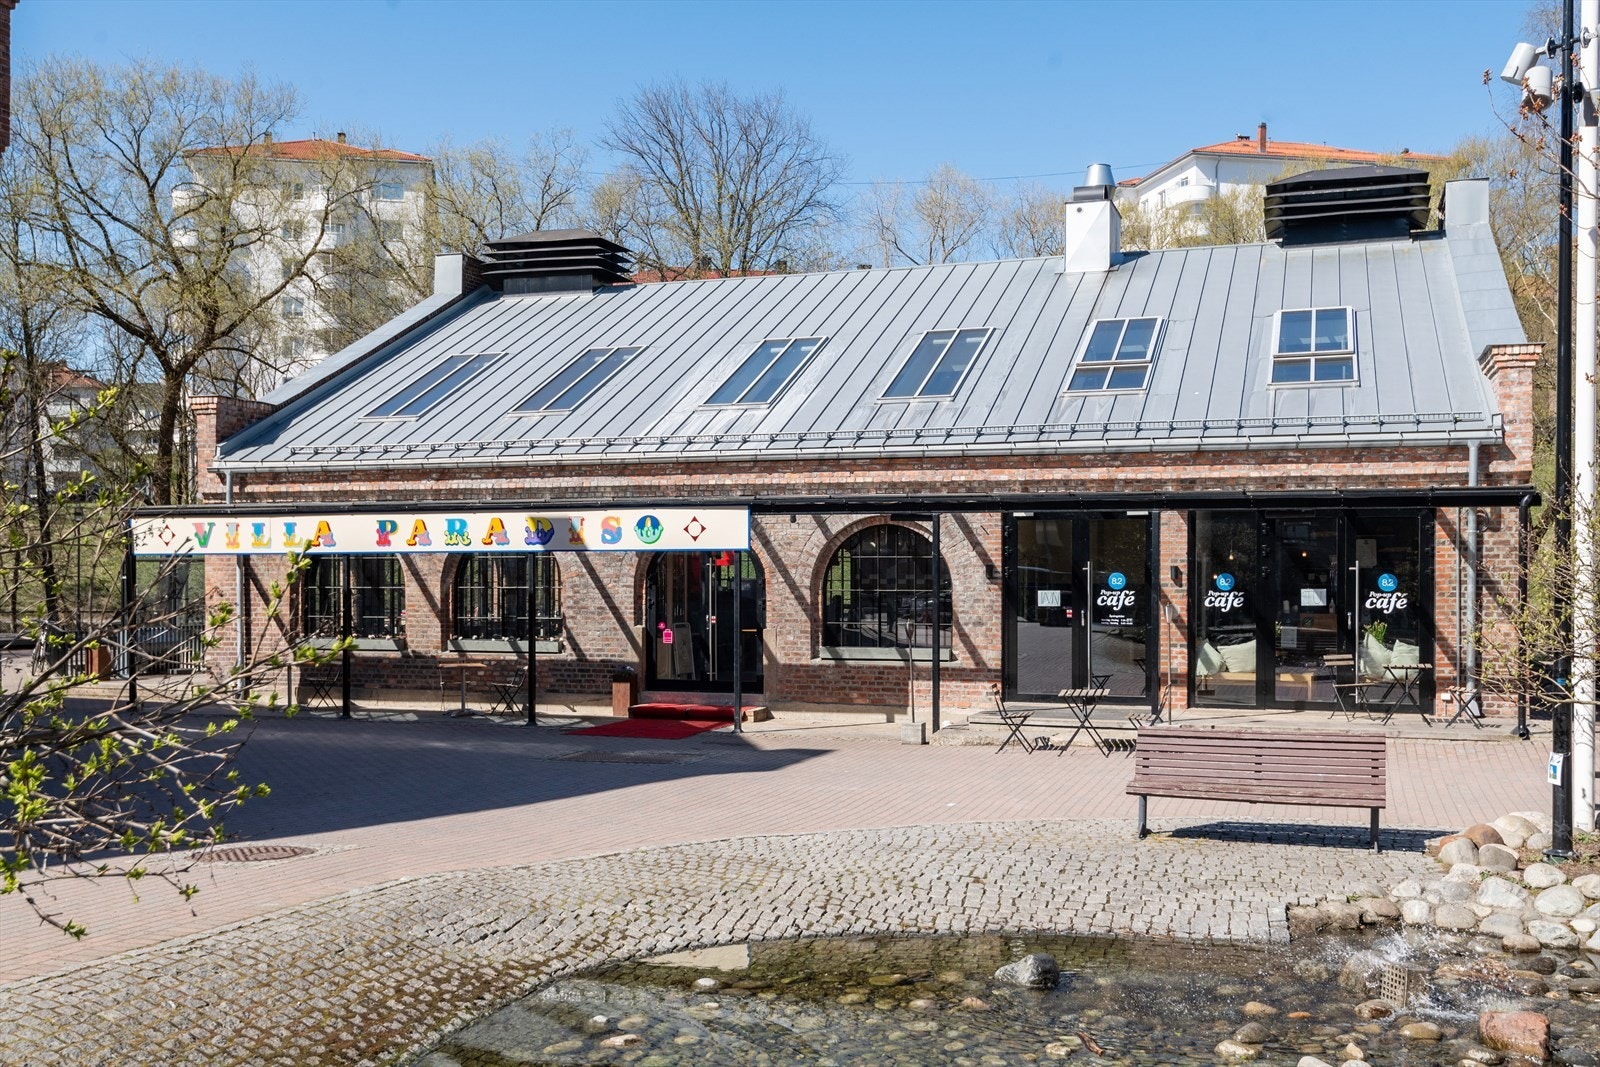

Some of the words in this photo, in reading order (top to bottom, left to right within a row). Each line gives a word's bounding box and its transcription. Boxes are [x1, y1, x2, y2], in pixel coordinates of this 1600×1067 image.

[192, 520, 336, 548] VILLA
[376, 514, 665, 547] PARADISO
[1111, 577, 1123, 585] 8.2
[1096, 590, 1135, 611] café
[1204, 591, 1244, 612] café
[1364, 592, 1408, 614] café
